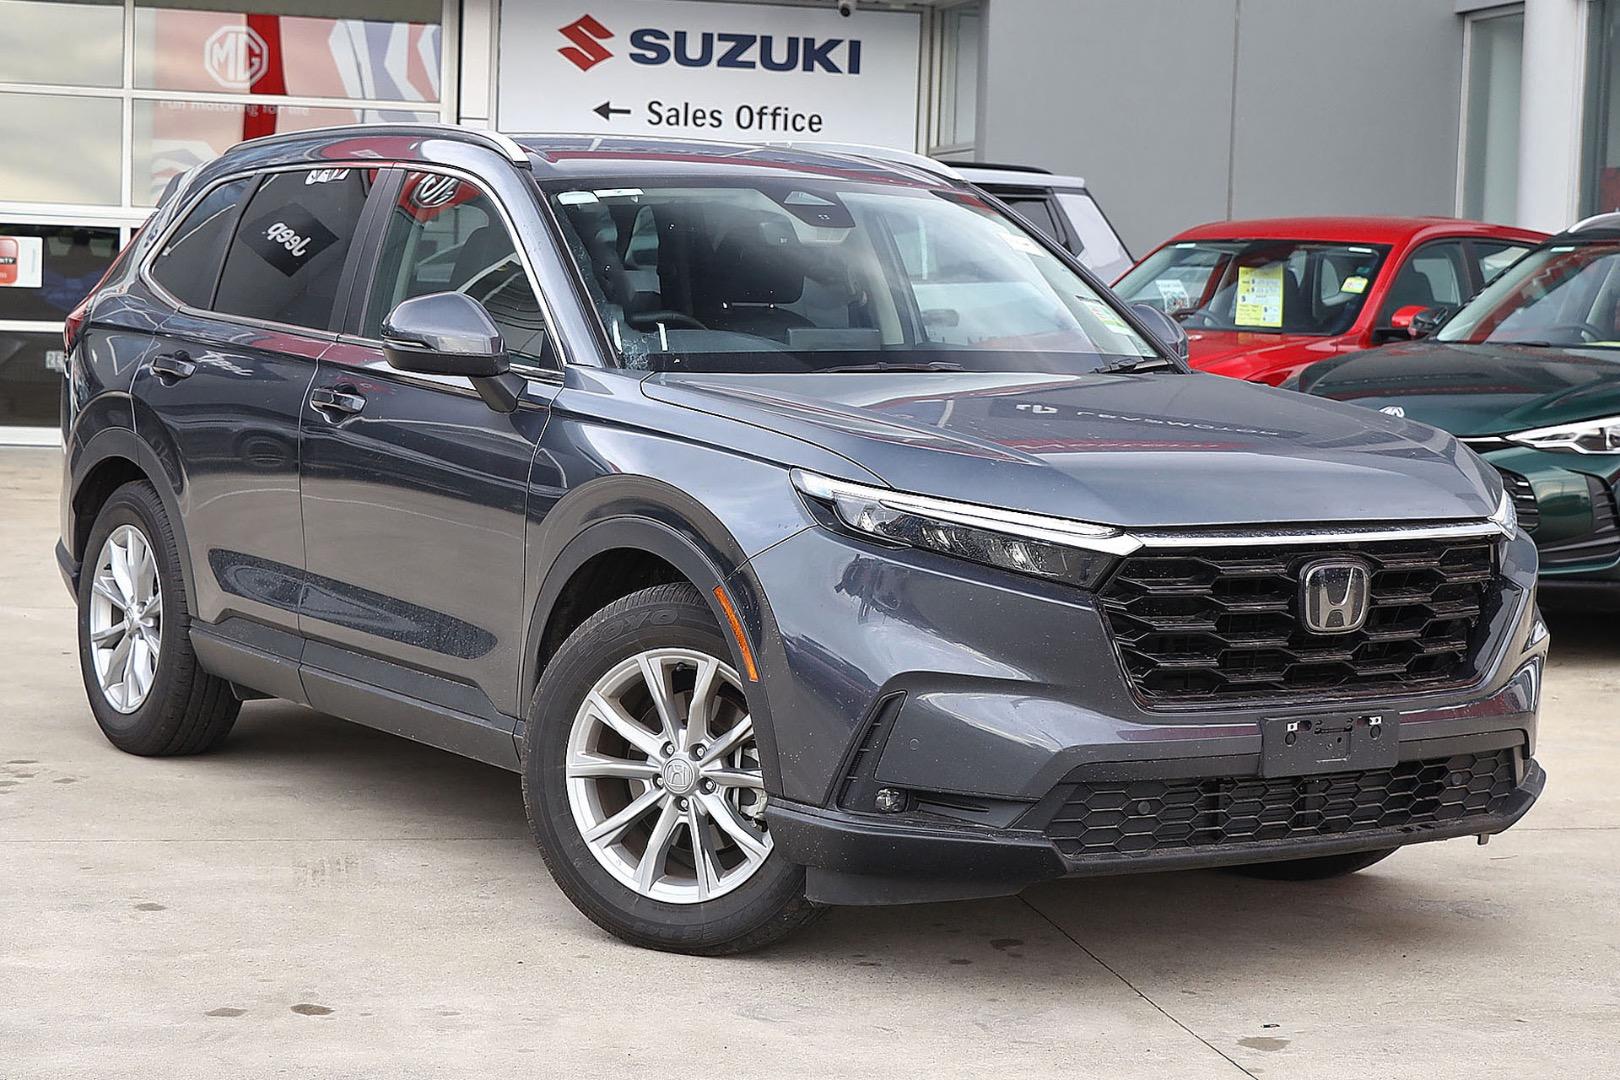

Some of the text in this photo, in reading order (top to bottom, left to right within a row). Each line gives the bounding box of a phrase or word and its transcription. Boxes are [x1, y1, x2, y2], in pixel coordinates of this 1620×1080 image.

[628, 28, 862, 75] SUZUKI
[647, 100, 824, 132] Sales Office
